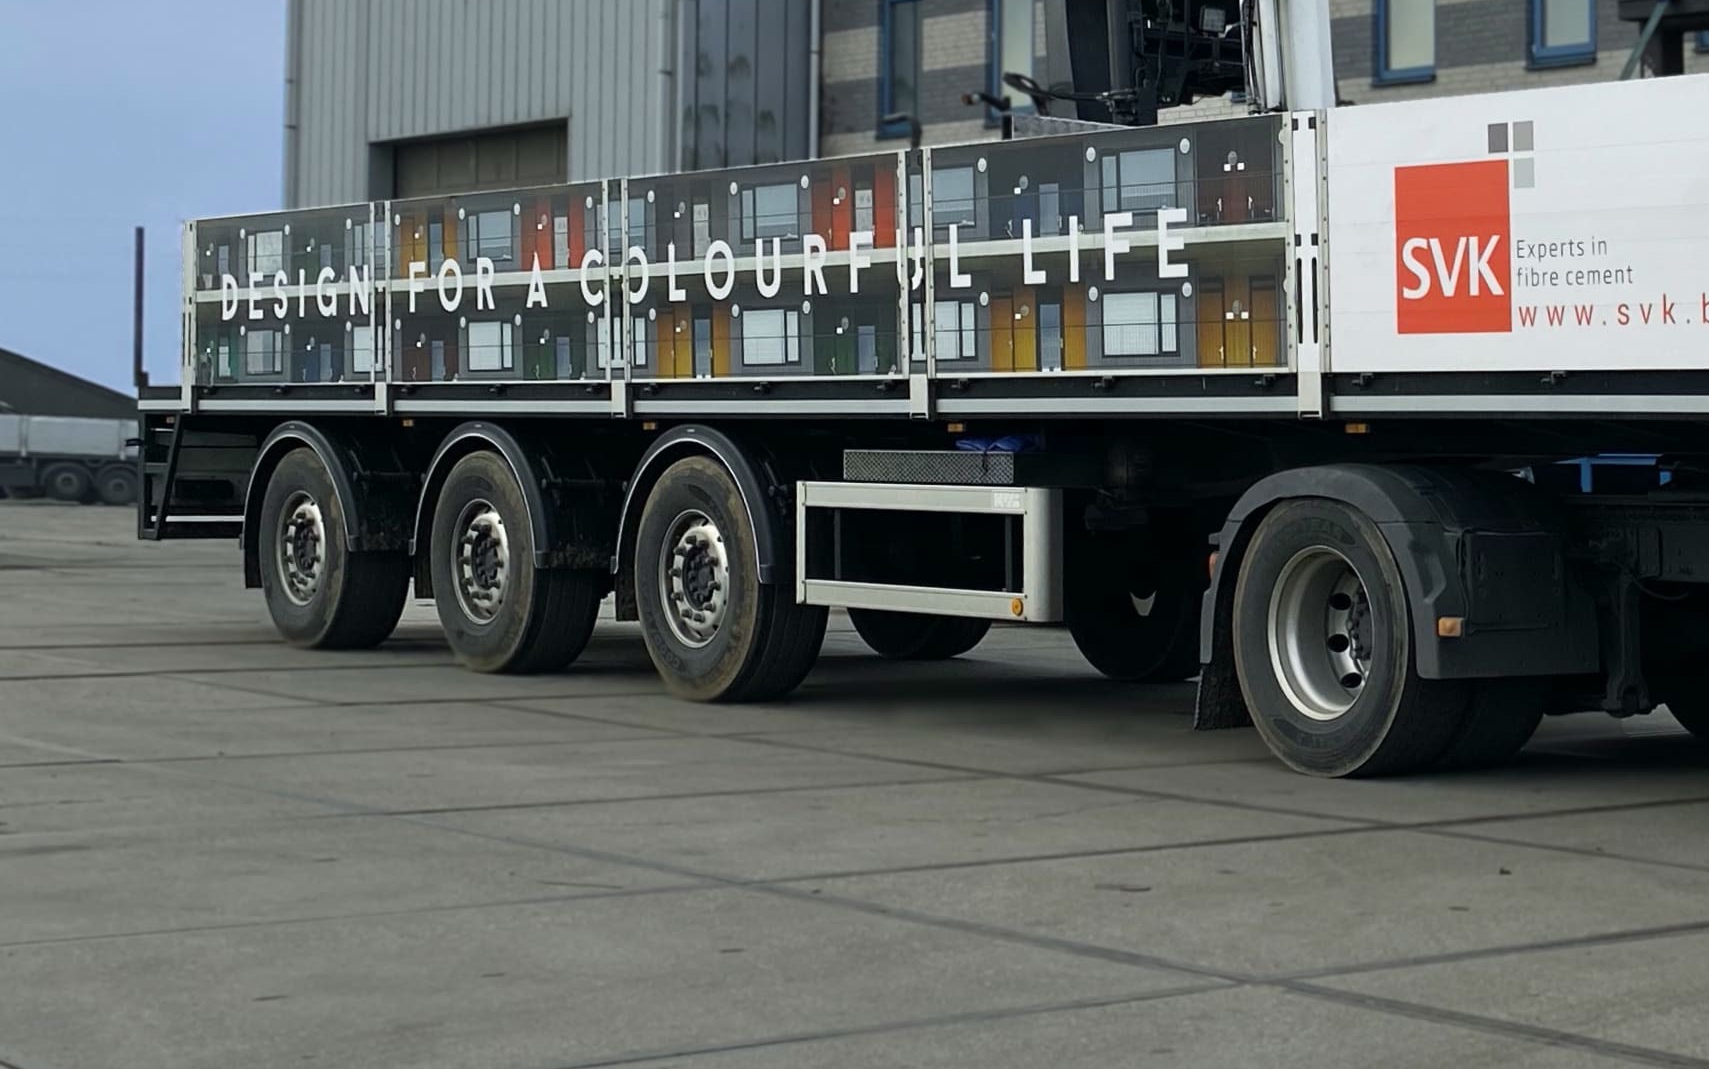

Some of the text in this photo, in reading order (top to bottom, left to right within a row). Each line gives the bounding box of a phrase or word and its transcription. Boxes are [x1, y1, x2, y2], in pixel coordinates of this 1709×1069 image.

[221, 208, 1189, 321] DESIGN FOR A COLOURFUL LIFE
[1402, 234, 1505, 300] SVK
[1516, 236, 1608, 263] Experts in
[1517, 265, 1634, 288] fibre cement
